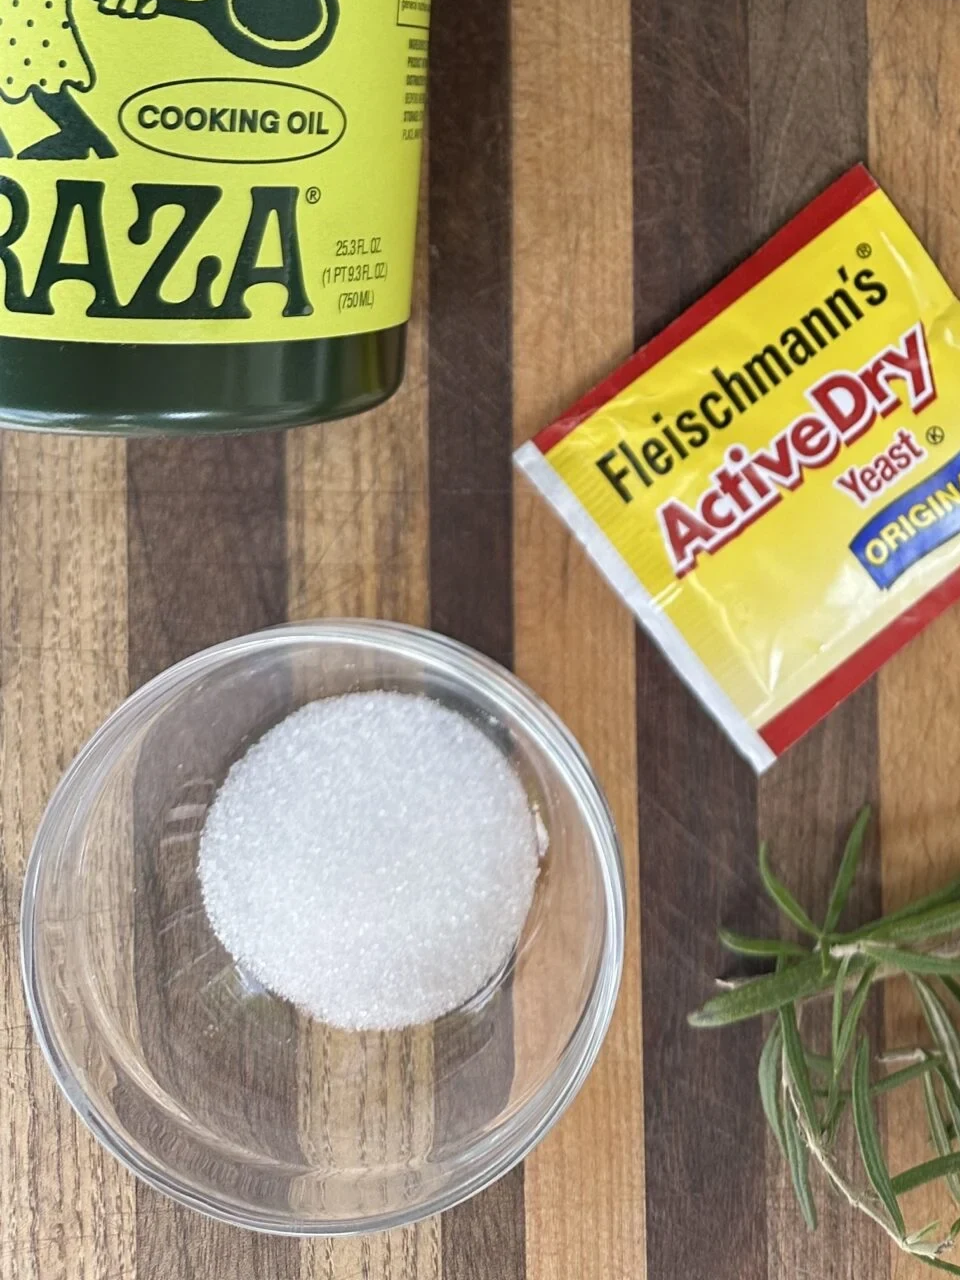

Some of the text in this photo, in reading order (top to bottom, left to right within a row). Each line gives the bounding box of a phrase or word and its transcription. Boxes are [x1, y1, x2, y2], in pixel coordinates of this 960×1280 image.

[137, 104, 330, 136] COOKING OIL
[594, 266, 890, 504] Fleischmann's
[838, 429, 925, 504] Yeast
